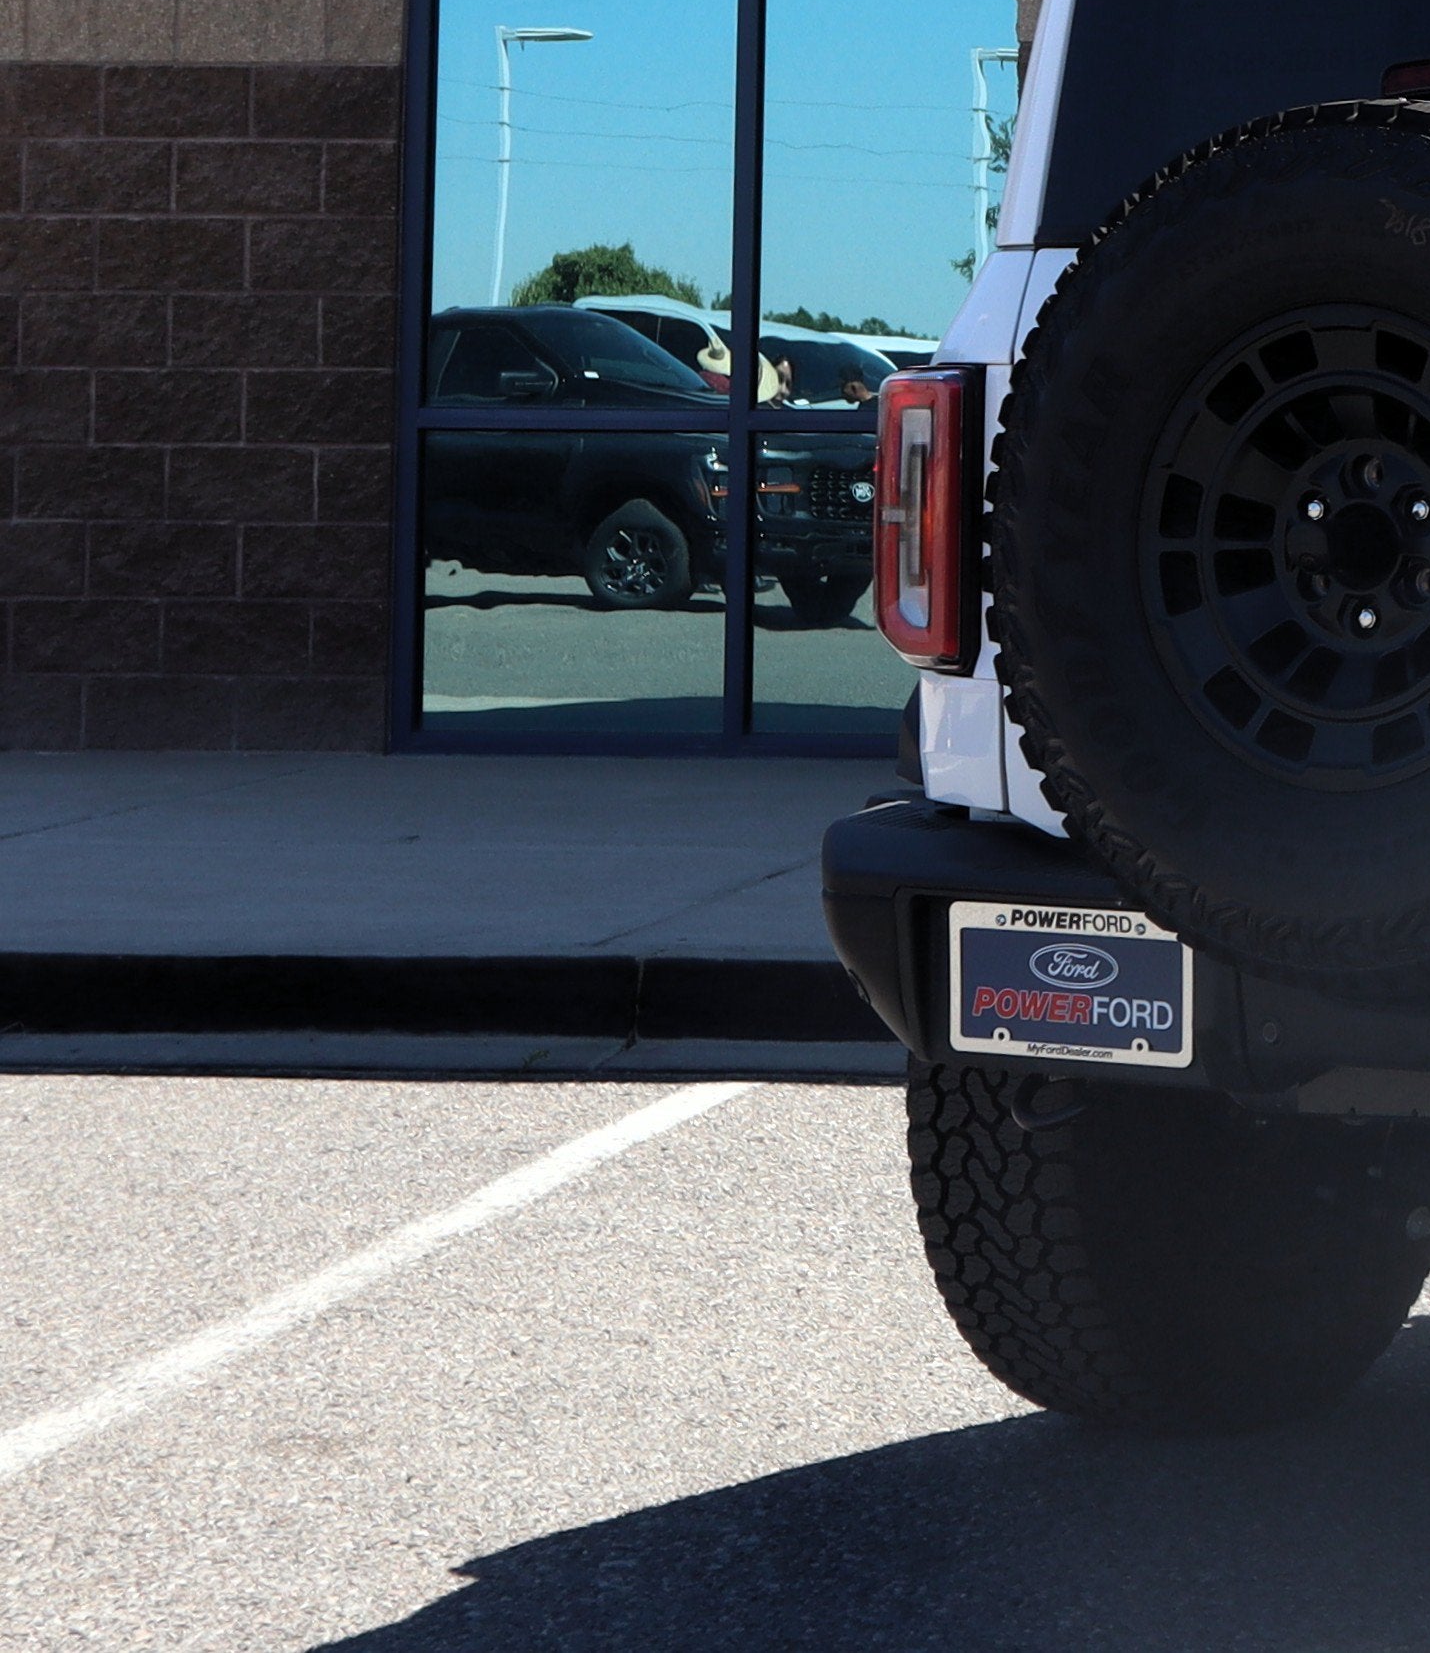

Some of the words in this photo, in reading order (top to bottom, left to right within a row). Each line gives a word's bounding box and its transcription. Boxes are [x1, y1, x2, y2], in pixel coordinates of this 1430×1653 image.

[1011, 909, 1132, 933] POWERFORD
[1047, 949, 1100, 979] Ford
[972, 986, 1173, 1030] POWERFORD
[1027, 1043, 1113, 1059] MyFordDealer.com
